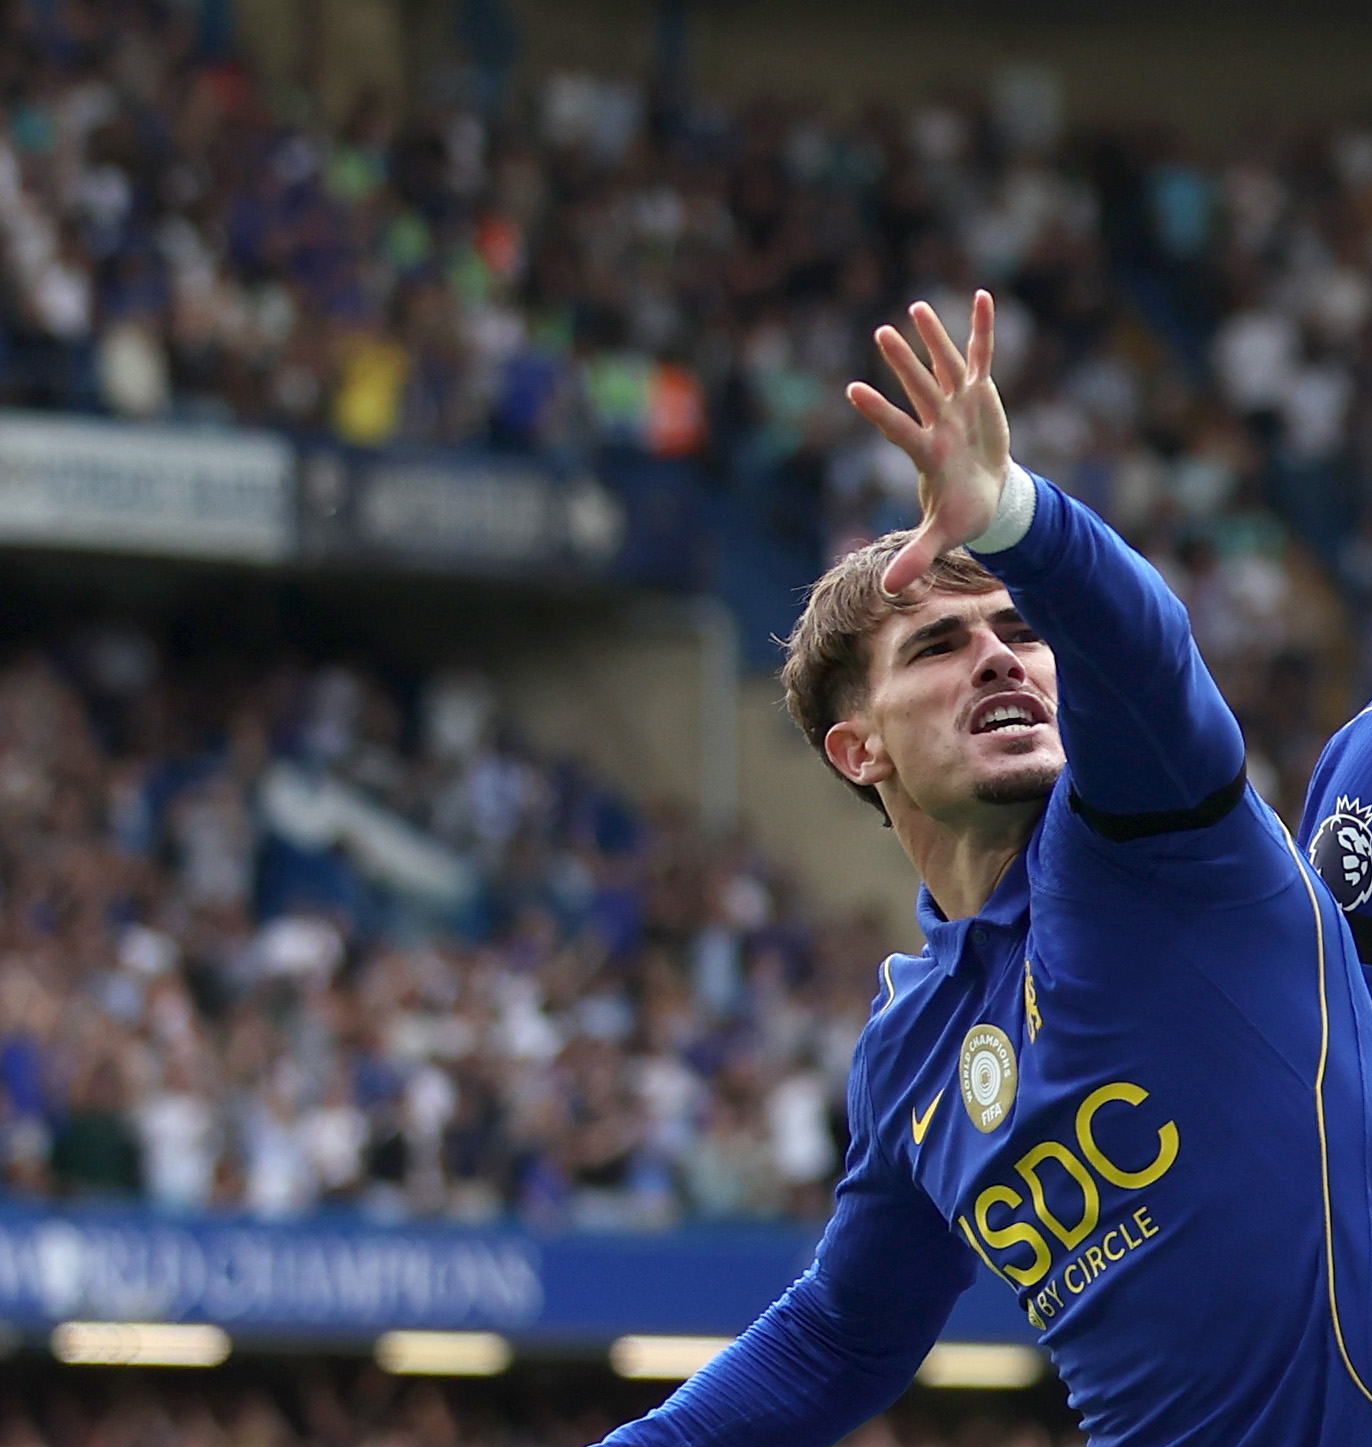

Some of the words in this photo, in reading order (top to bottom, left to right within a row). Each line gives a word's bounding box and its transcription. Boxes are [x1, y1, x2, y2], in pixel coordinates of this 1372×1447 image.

[963, 1051, 974, 1103] WORLD
[968, 1033, 1012, 1078] CHAMPIONS
[981, 1101, 1003, 1127] FIFA
[1036, 1279, 1065, 1318] BY
[1063, 1205, 1161, 1295] CIRCLE
